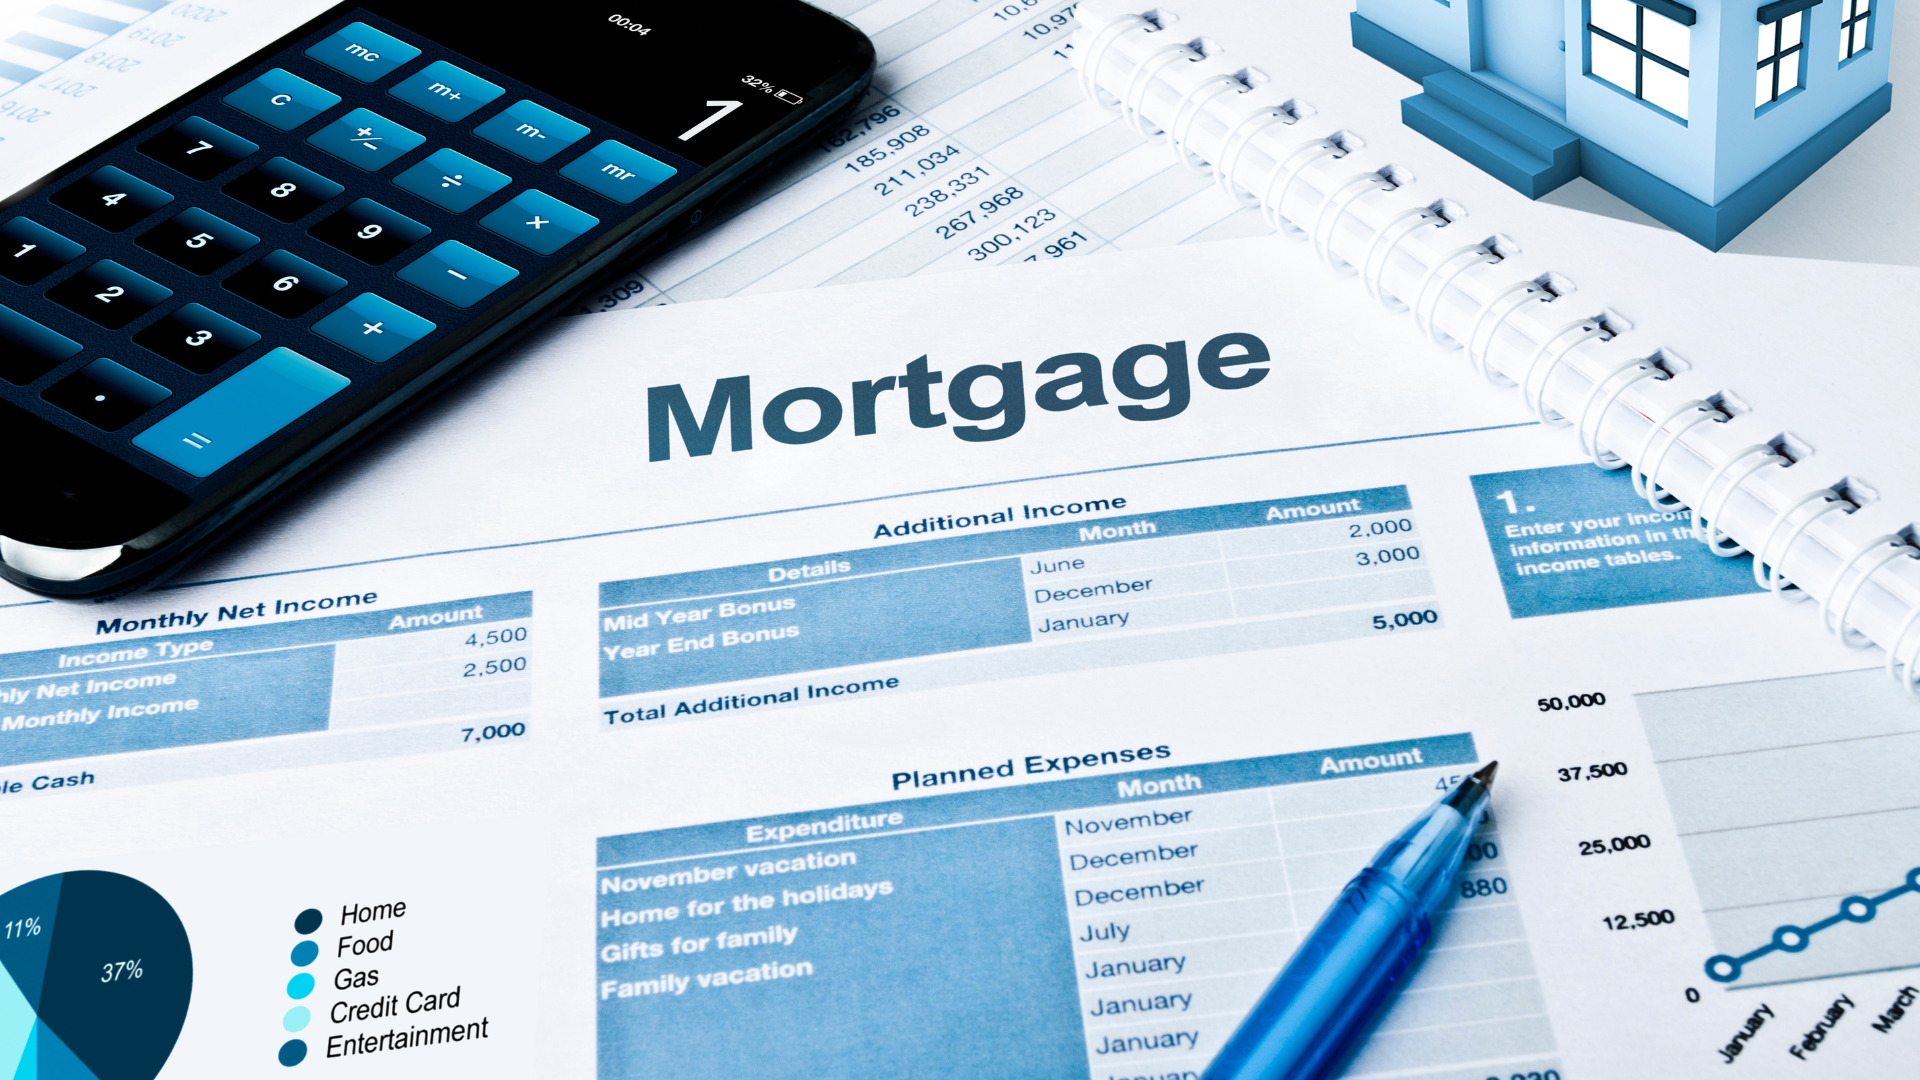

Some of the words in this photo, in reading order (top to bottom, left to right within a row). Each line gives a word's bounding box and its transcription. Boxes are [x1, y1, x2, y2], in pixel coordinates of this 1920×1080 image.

[171, 3, 228, 23] 2020
[608, 13, 651, 37] 00:04
[1023, 2, 1080, 43] 10,97
[128, 27, 186, 48] 2019
[84, 51, 142, 73] 2018
[344, 42, 380, 63] mc
[38, 77, 97, 98] 2017
[428, 81, 462, 102] m+
[741, 75, 776, 94] 32%
[515, 122, 546, 140] m-
[677, 100, 743, 142] 1
[816, 105, 901, 154] 162,796
[186, 141, 214, 155] 7
[845, 125, 930, 173] 185,908
[601, 161, 636, 182] mr
[874, 145, 960, 196] 211,034
[102, 192, 127, 207] 4
[271, 182, 297, 198] 8
[904, 166, 990, 217] 238,331
[936, 186, 1024, 239] 267,968
[186, 233, 214, 249] 5
[357, 224, 383, 239] 9
[968, 208, 1056, 261] 300,123
[14, 243, 37, 258] 1
[95, 286, 125, 303] 2
[273, 276, 299, 292] 6
[186, 330, 213, 346] 3
[647, 332, 1271, 463] Mortgage
[1496, 490, 1536, 514] 1.
[873, 507, 1013, 540] Additional
[1024, 494, 1127, 520] Income
[1349, 518, 1412, 539] 2,000
[1505, 522, 1564, 539] Enter
[1570, 515, 1621, 535] your
[768, 559, 851, 583] Details
[1079, 520, 1157, 542] Month
[1266, 498, 1362, 522] Amount
[1510, 531, 1640, 557] information
[1646, 528, 1669, 543] in
[1031, 557, 1085, 575] June
[1356, 546, 1420, 568] 3,000
[1516, 555, 1600, 576] income
[1605, 547, 1681, 568] tables.
[1035, 576, 1153, 604] December
[95, 608, 208, 635] Monthly
[218, 601, 265, 621] Net
[275, 589, 378, 615] Income
[604, 613, 649, 632] Mid
[655, 605, 712, 626] Year
[719, 598, 796, 618] Bonus
[1037, 609, 1130, 635] January
[1373, 609, 1438, 631] 5,000
[58, 644, 148, 668] Income
[156, 637, 214, 659] Type
[388, 605, 483, 630] Amount
[465, 626, 527, 649] 4,500
[604, 643, 661, 661] Year
[667, 634, 714, 654] End
[722, 625, 799, 646] Bonus
[463, 656, 527, 679] 2,500
[36, 683, 80, 700] Net
[86, 674, 177, 694] Income
[604, 704, 666, 726] Total
[674, 688, 799, 717] Additional
[808, 676, 900, 700] Income
[1538, 692, 1606, 712] 50,000
[2, 708, 101, 732] Monthly
[108, 699, 199, 719] Income
[461, 722, 525, 744] 7,000
[892, 759, 1014, 790] Planned
[1025, 744, 1171, 776] Expenses
[1558, 762, 1628, 782] 37,500
[32, 771, 95, 791] Cash
[746, 812, 903, 844] Expenditure
[1117, 774, 1202, 799] Month
[1320, 747, 1423, 775] Amount
[1065, 807, 1193, 837] November
[1070, 842, 1198, 872] December
[1579, 834, 1651, 856] 25,000
[601, 864, 737, 894] November
[744, 849, 857, 877] vacation
[1075, 877, 1205, 907] December
[1460, 877, 1508, 899] 880
[341, 899, 407, 926] Home
[601, 905, 679, 928] Home
[687, 899, 725, 919] for
[733, 892, 773, 912] the
[782, 879, 893, 907] holidays
[4, 917, 42, 940] 11%
[1079, 922, 1130, 943] July
[1602, 909, 1675, 931] 12,500
[337, 930, 394, 958] Food
[601, 941, 663, 963] Gifts
[671, 934, 709, 955] for
[716, 924, 798, 951] family
[101, 959, 144, 983] 37%
[334, 967, 379, 990] Gas
[1085, 954, 1185, 979] January
[601, 973, 690, 1000] Family
[697, 959, 813, 988] vacation
[330, 995, 398, 1024] Credit
[406, 986, 461, 1015] Card
[1091, 991, 1192, 1017] January
[1685, 988, 1700, 1003] 0
[1871, 985, 1919, 1034] March
[326, 1016, 489, 1059] Entertainment
[1717, 1002, 1775, 1063] January
[1789, 993, 1855, 1061] February
[1096, 1029, 1198, 1055] January
